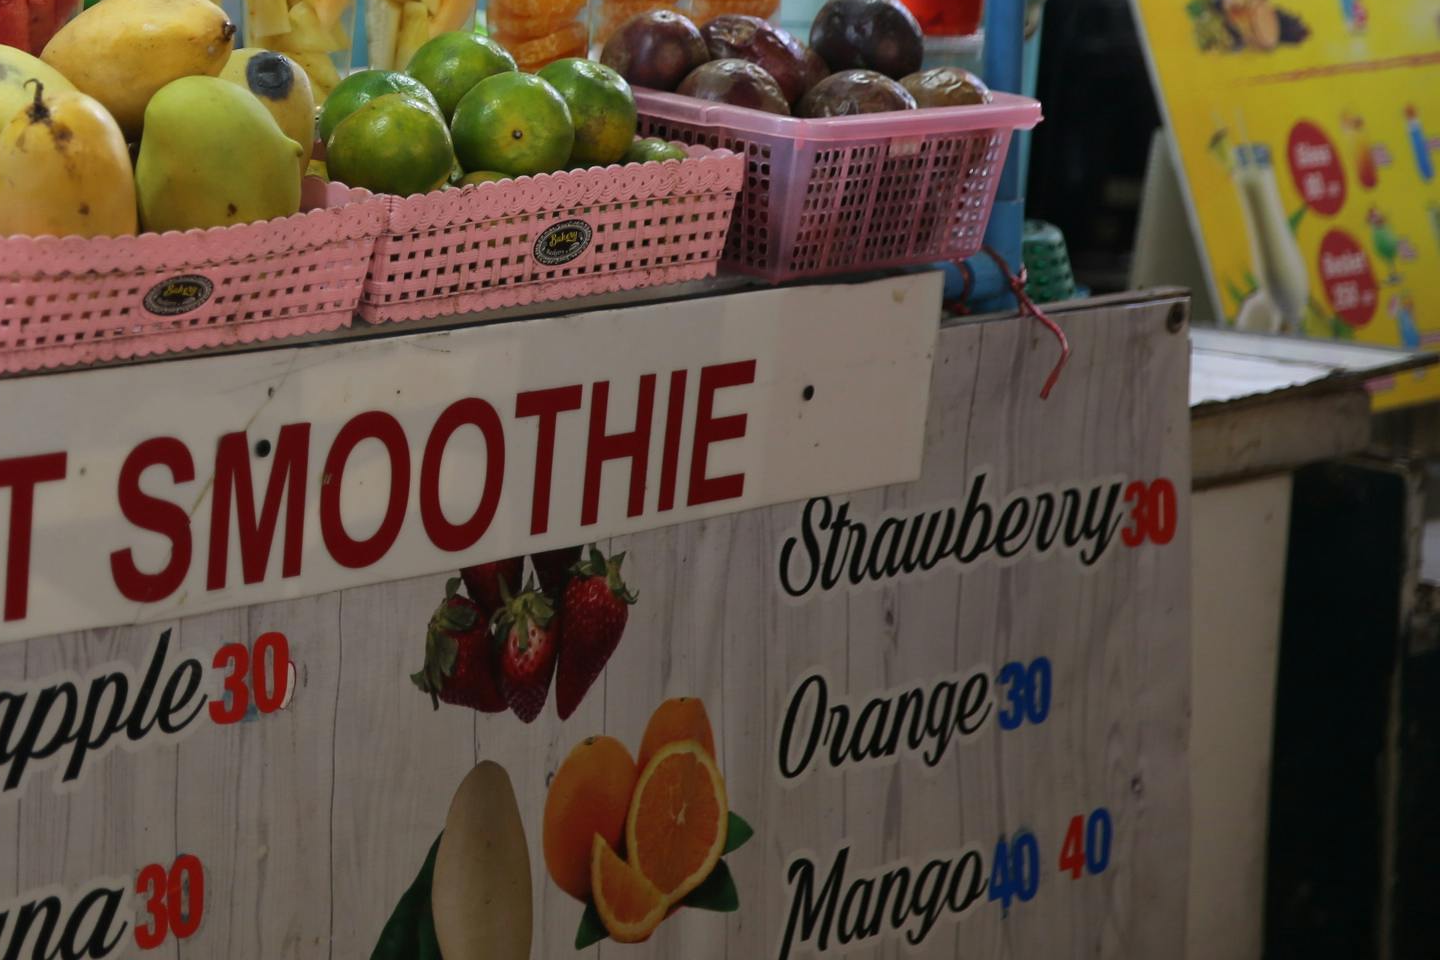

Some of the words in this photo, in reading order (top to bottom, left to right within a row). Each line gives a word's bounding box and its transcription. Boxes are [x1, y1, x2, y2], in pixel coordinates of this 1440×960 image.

[109, 358, 757, 604] SMOOTHIE
[779, 473, 1124, 597] Strawberry
[1121, 477, 1177, 548] 30
[208, 631, 289, 725] 30
[778, 672, 993, 779] Orange
[996, 655, 1053, 731] 30
[134, 853, 204, 950] 30
[778, 846, 990, 960] Mango
[988, 832, 1040, 916] 40
[1058, 806, 1113, 881] 40
